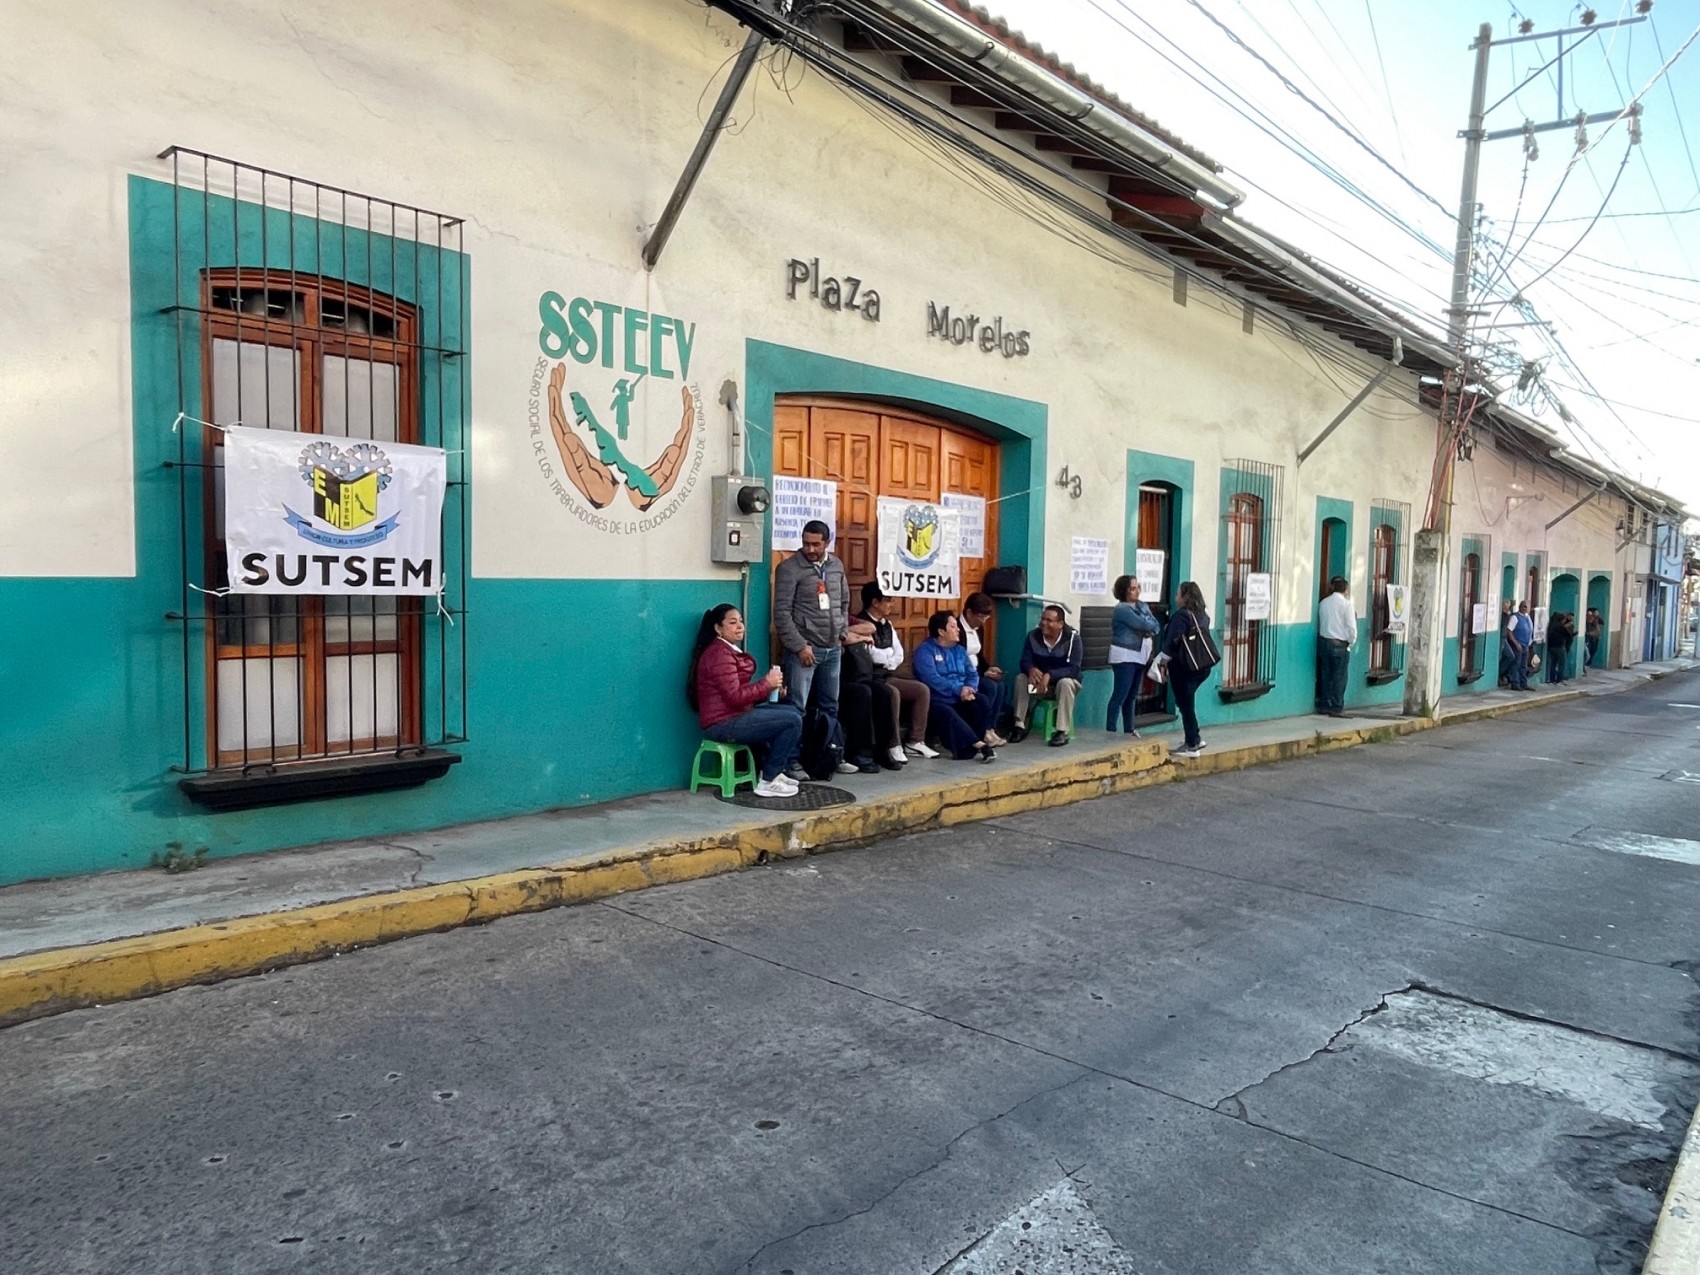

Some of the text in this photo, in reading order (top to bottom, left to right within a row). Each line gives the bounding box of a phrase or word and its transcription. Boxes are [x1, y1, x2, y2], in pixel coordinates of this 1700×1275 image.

[787, 257, 1031, 358] Plaza Morelos
[539, 290, 696, 382] SSTEEV
[529, 356, 548, 398] SEGURO
[528, 398, 541, 438] SOCIAL
[532, 440, 545, 456] DE
[695, 438, 706, 451] DE
[538, 457, 553, 479] LOS
[686, 451, 704, 488] ESTADO
[549, 478, 608, 532] TRABAJADORES
[677, 486, 692, 504] DEL
[609, 520, 621, 534] DE
[624, 521, 637, 535] LA
[241, 552, 433, 587] SUTSEM
[881, 570, 953, 594] SUTSEM
